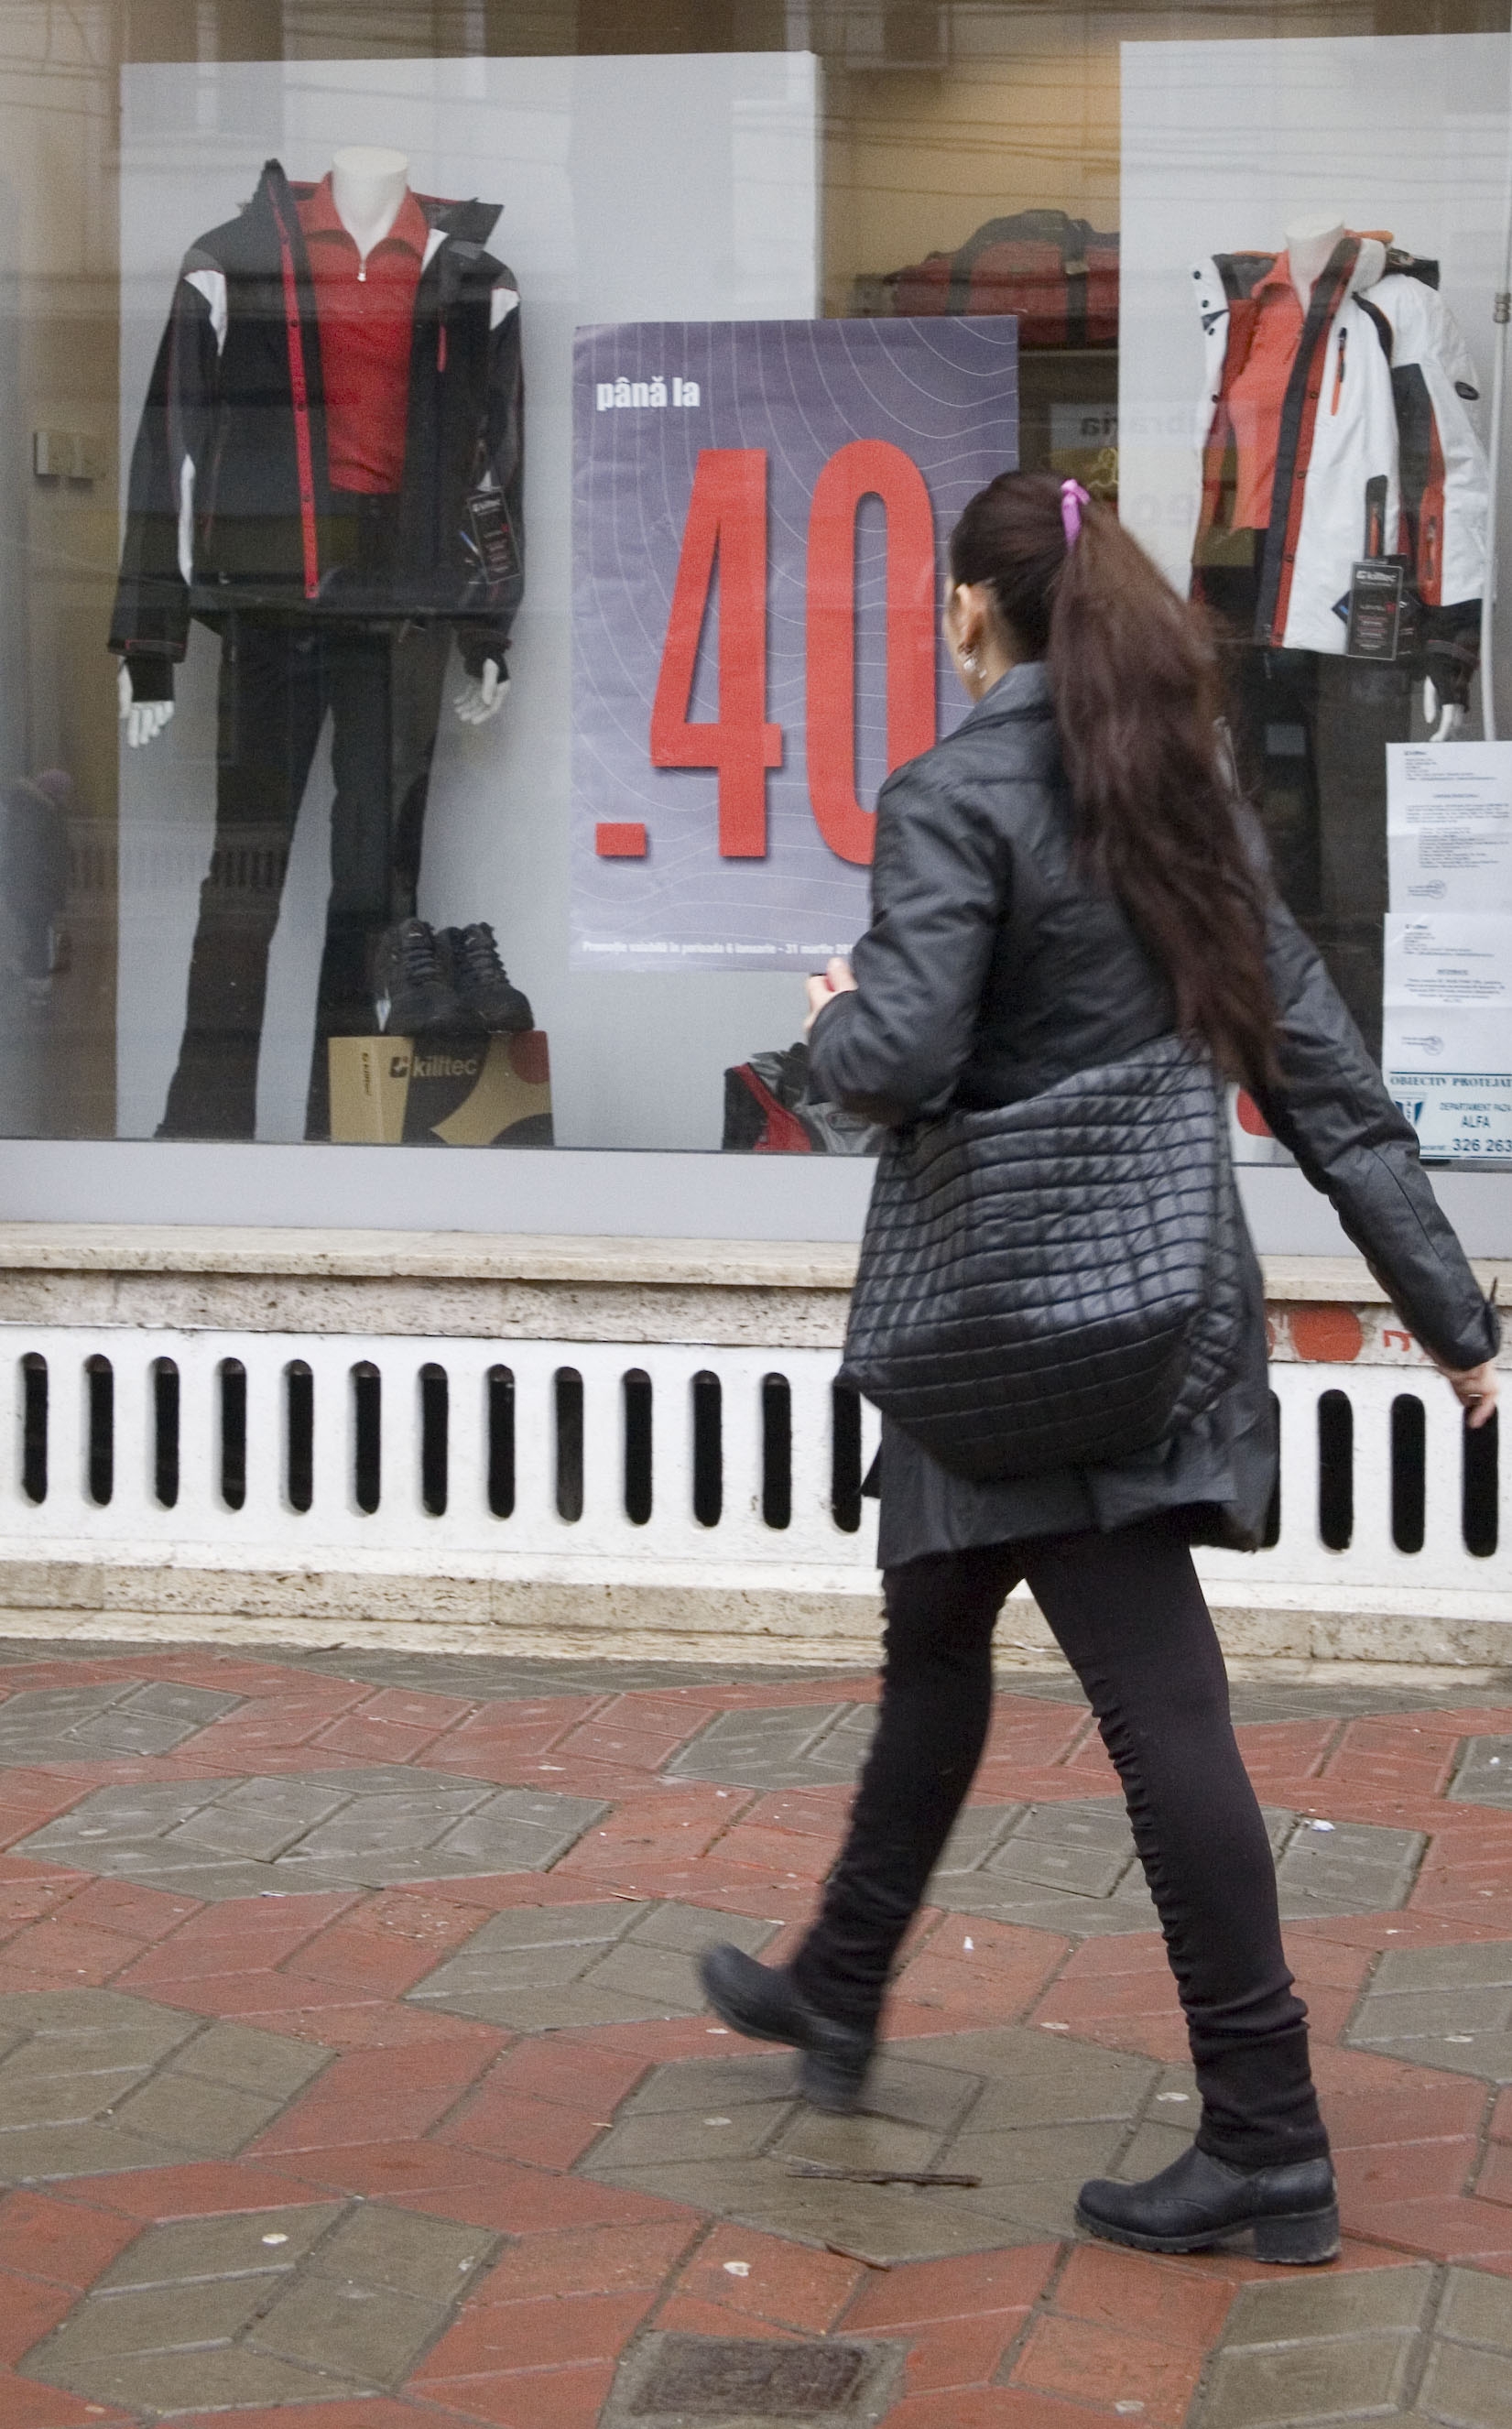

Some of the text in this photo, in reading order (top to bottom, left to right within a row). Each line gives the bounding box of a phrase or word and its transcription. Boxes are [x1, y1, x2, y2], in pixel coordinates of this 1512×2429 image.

[596, 376, 701, 411] până la
[413, 1055, 478, 1078] killtec
[1390, 1076, 1447, 1087] OBIECTIV
[1461, 1115, 1492, 1128] ALFA
[1452, 1138, 1481, 1152] 326
[1485, 1138, 1512, 1153] 263
